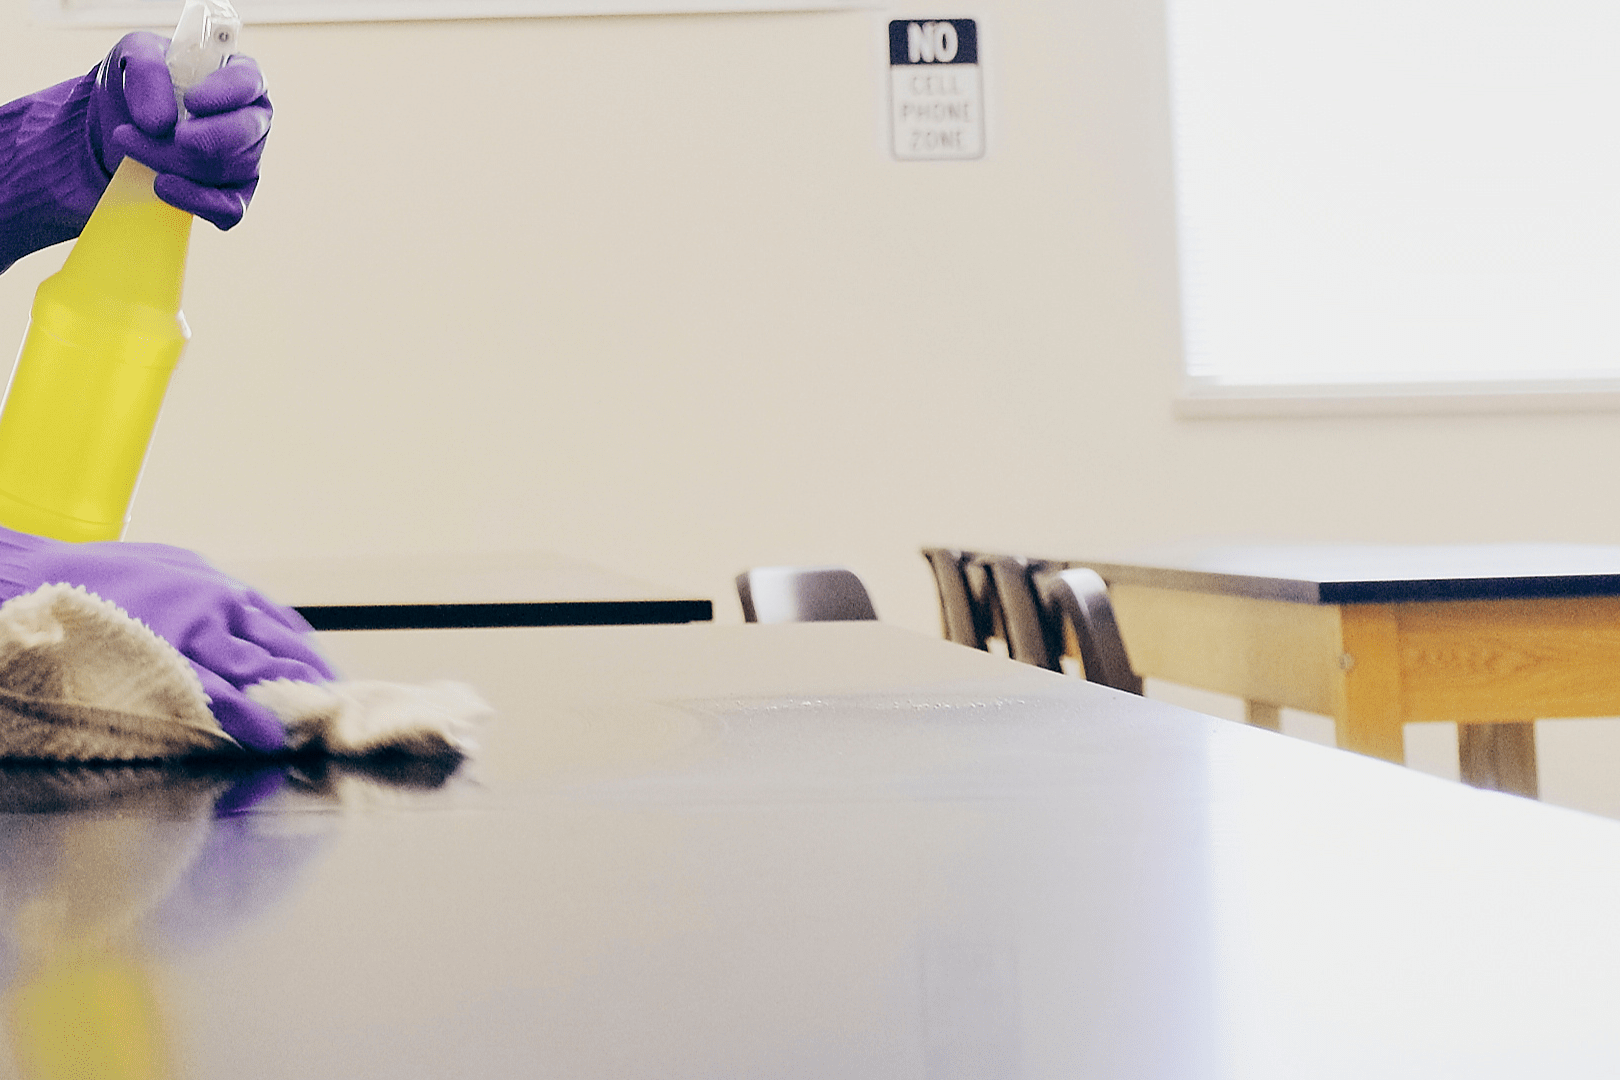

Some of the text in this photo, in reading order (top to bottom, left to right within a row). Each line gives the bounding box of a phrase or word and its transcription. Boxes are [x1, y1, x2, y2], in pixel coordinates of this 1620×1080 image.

[907, 21, 959, 63] NO
[912, 76, 958, 95] CELL
[902, 102, 971, 123] PHONE
[911, 130, 961, 150] ZONE
